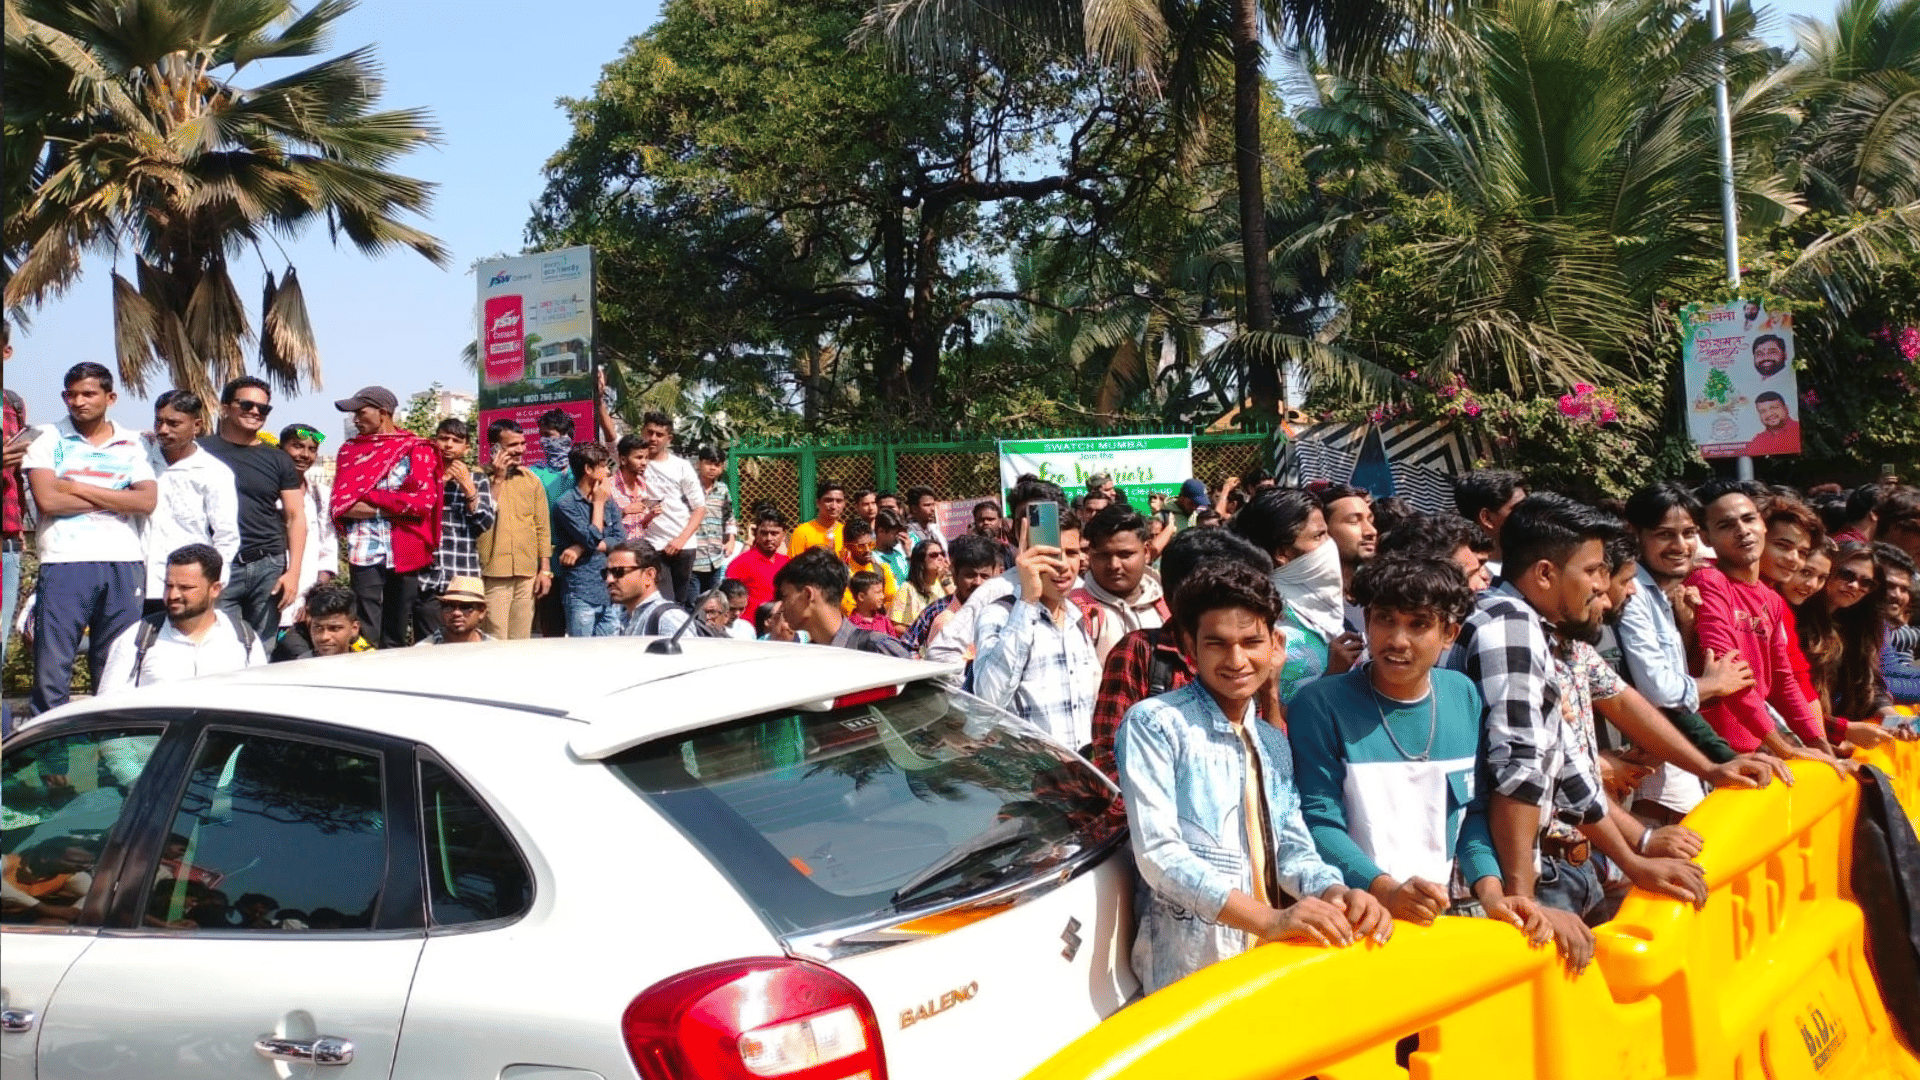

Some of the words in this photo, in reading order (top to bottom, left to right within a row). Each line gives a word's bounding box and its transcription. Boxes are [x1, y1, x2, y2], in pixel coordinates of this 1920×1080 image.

[488, 271, 511, 288] JSW
[490, 311, 520, 332] JSW
[523, 394, 539, 403] 1800
[1044, 442, 1094, 452] SWATCH
[1098, 440, 1148, 450] MUMBAI
[1079, 453, 1098, 461] Join
[1100, 451, 1114, 459] the
[899, 980, 979, 1030] BALENO
